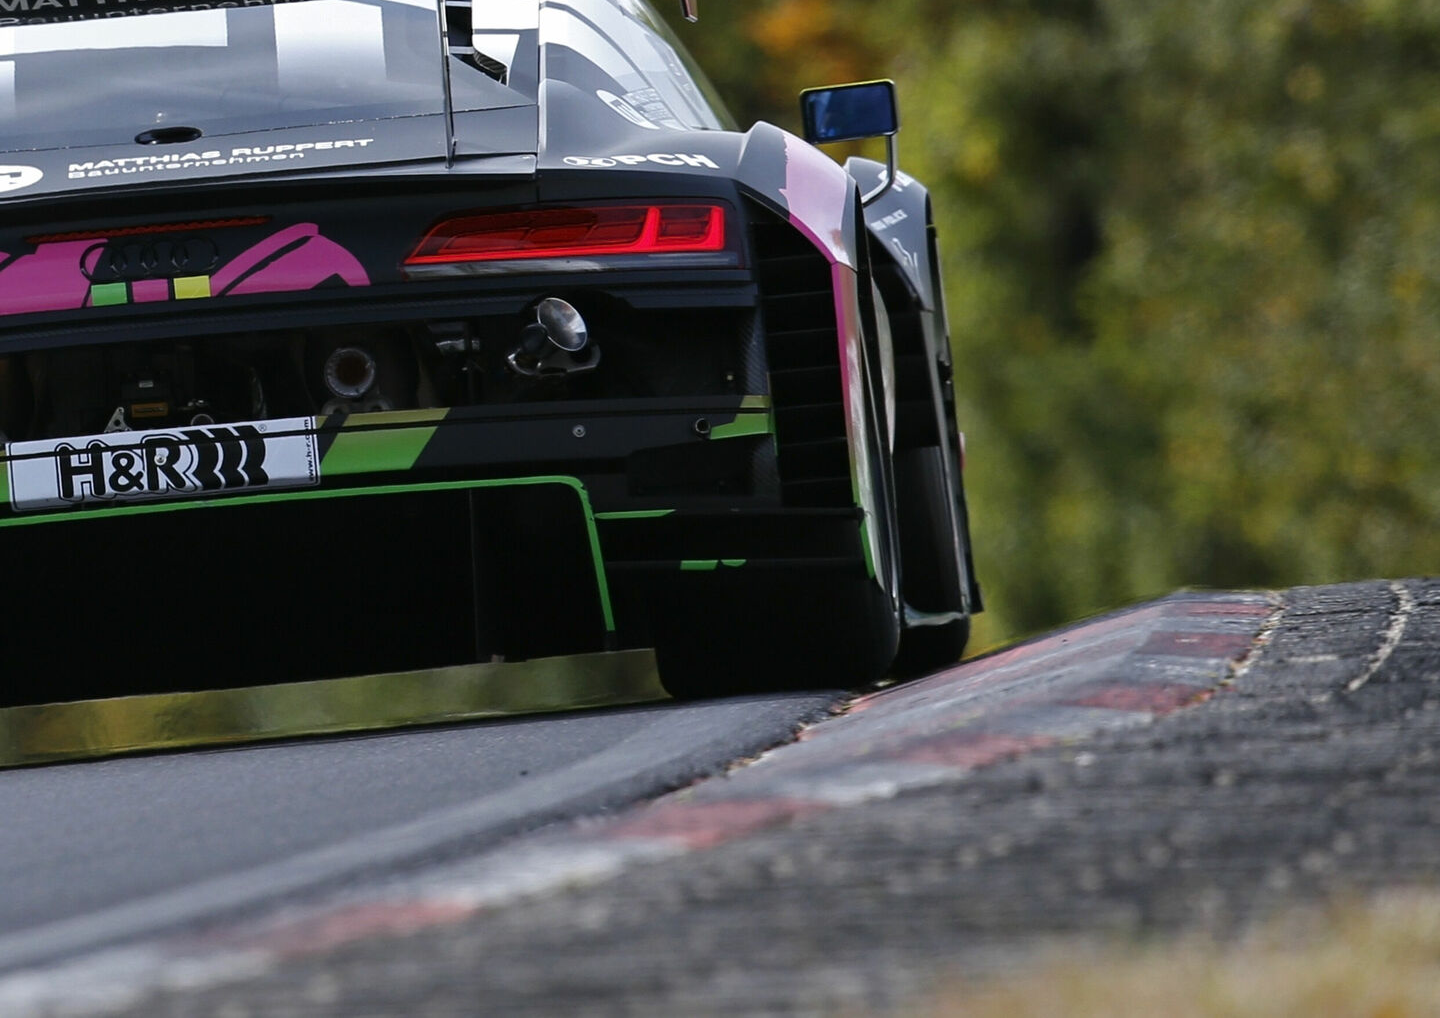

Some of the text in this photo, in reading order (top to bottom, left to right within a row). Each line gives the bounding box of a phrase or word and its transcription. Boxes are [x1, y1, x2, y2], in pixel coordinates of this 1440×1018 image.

[68, 138, 374, 172] MATTHIAS RUPPERT
[57, 435, 196, 500] H&R
[303, 418, 315, 483] www.h-r.cm
